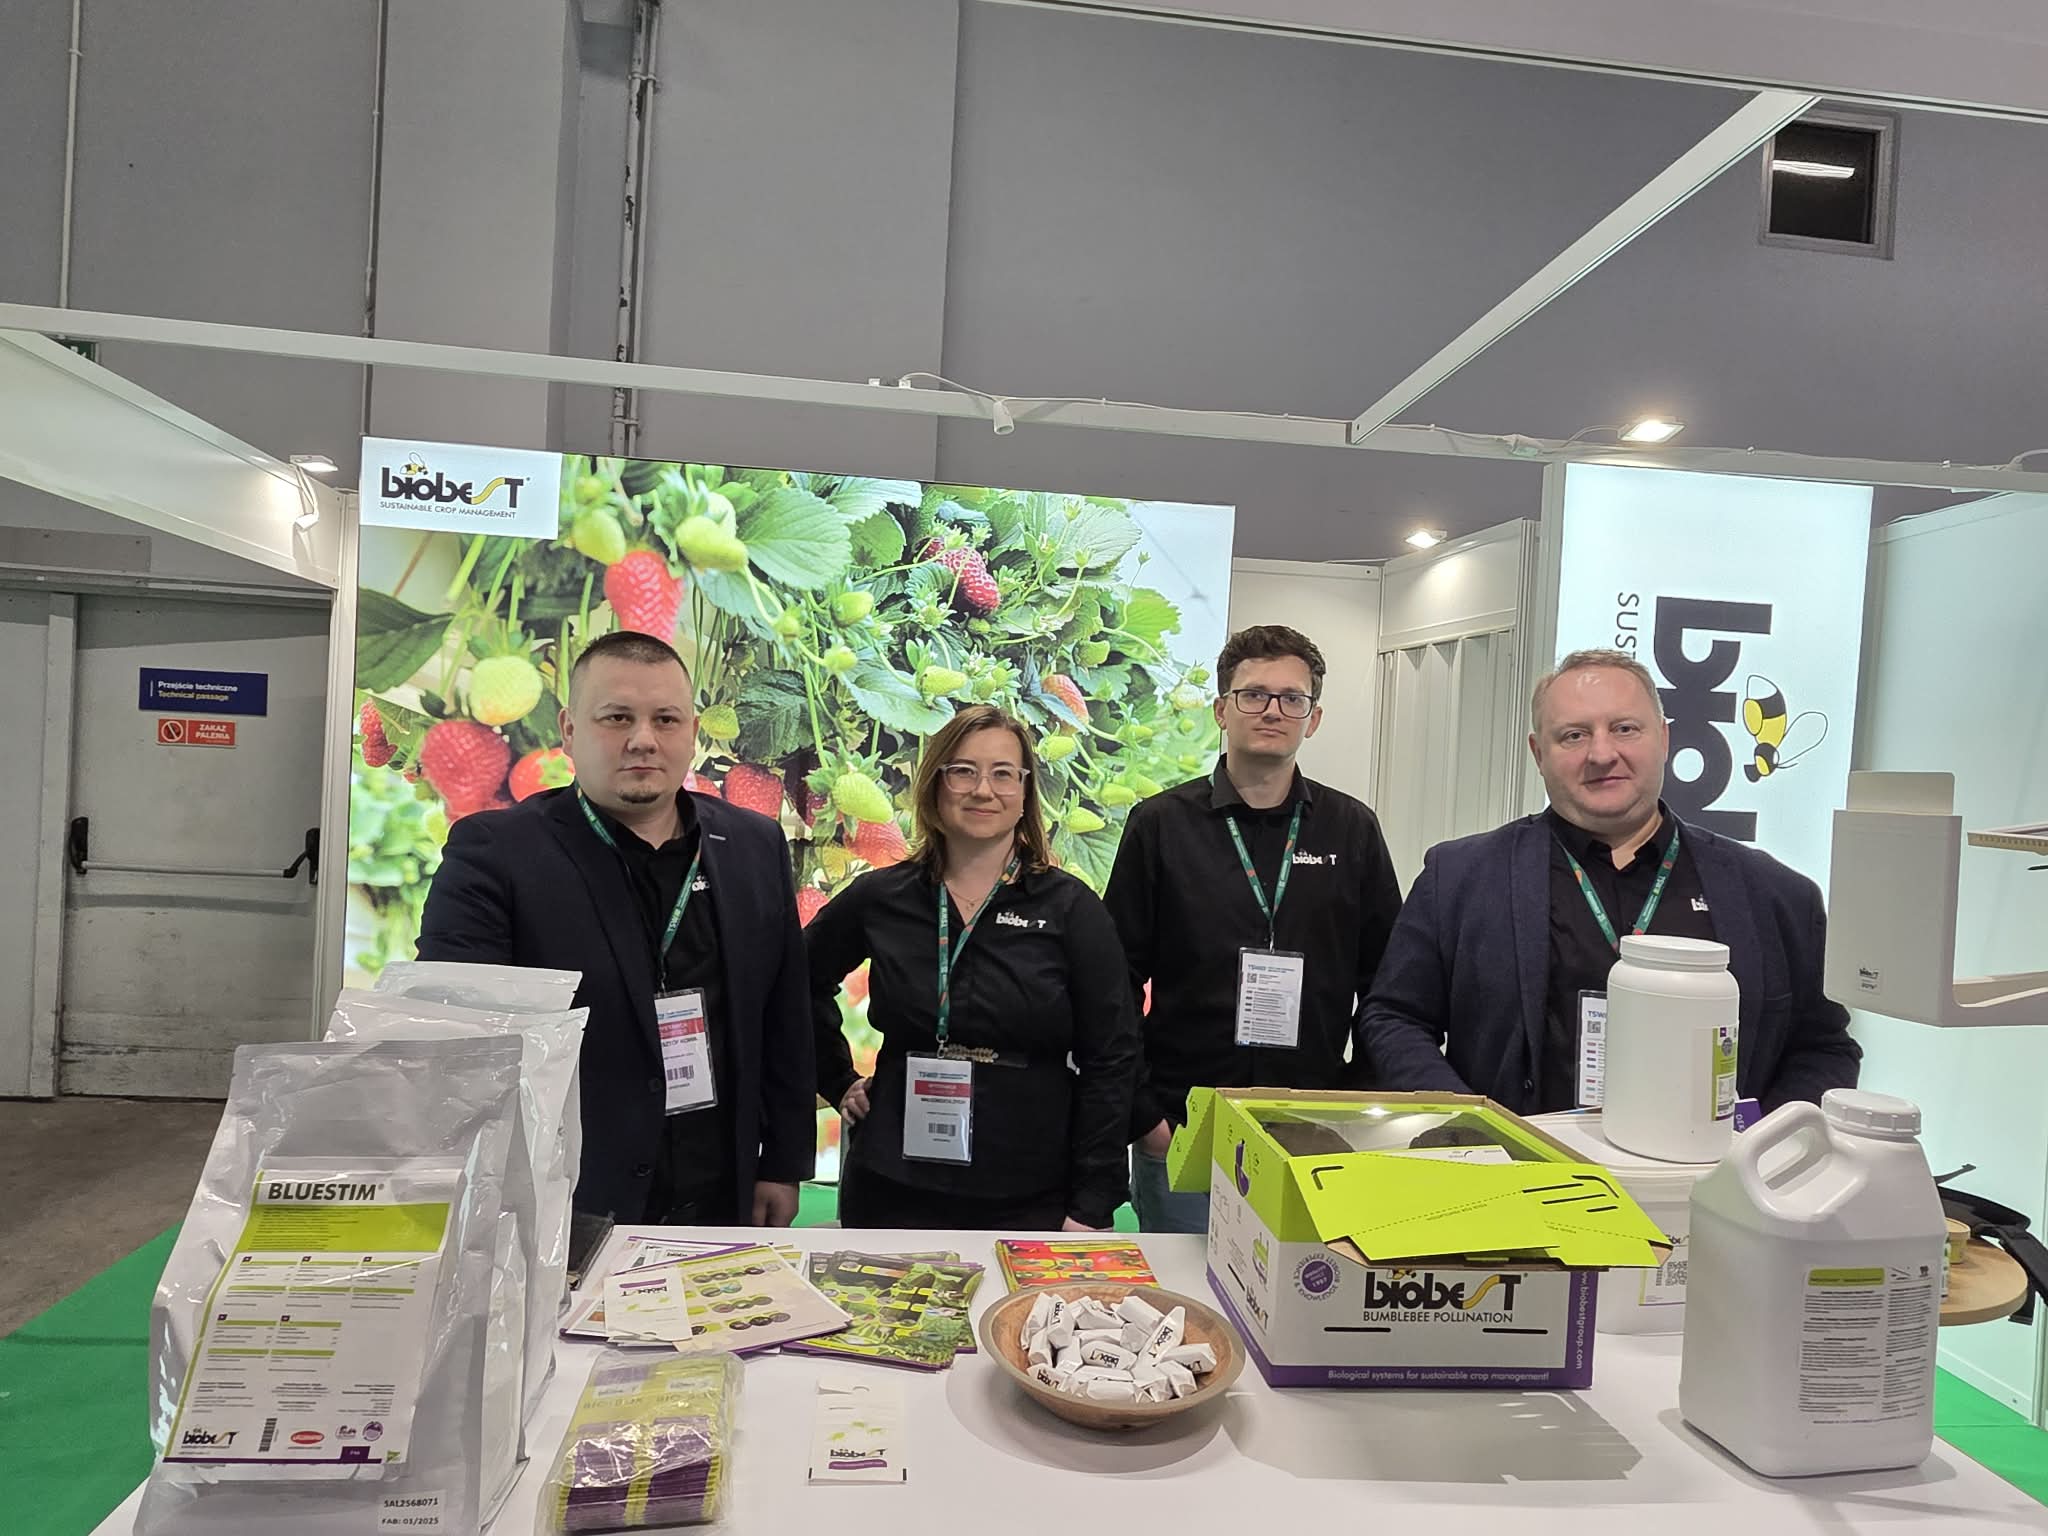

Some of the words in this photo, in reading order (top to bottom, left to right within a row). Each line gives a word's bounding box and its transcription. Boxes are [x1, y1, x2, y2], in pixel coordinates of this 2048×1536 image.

[380, 501, 432, 512] SUSTAINABLE
[434, 506, 457, 514] CROP
[458, 508, 517, 518] MANAGEMENT
[158, 681, 194, 690] Przejście
[195, 683, 238, 692] techniczne
[199, 724, 227, 732] ZAKAZ
[195, 731, 231, 740] PALENIA
[267, 1182, 377, 1201] BLUESTIM
[1363, 1310, 1431, 1323] BUMBLEBEE
[1434, 1311, 1514, 1324] POLLINATION
[1328, 1369, 1370, 1381] Biological
[1371, 1371, 1404, 1381] systems
[1406, 1371, 1419, 1380] for
[1420, 1371, 1468, 1381] sustainable
[1470, 1373, 1489, 1382] crop
